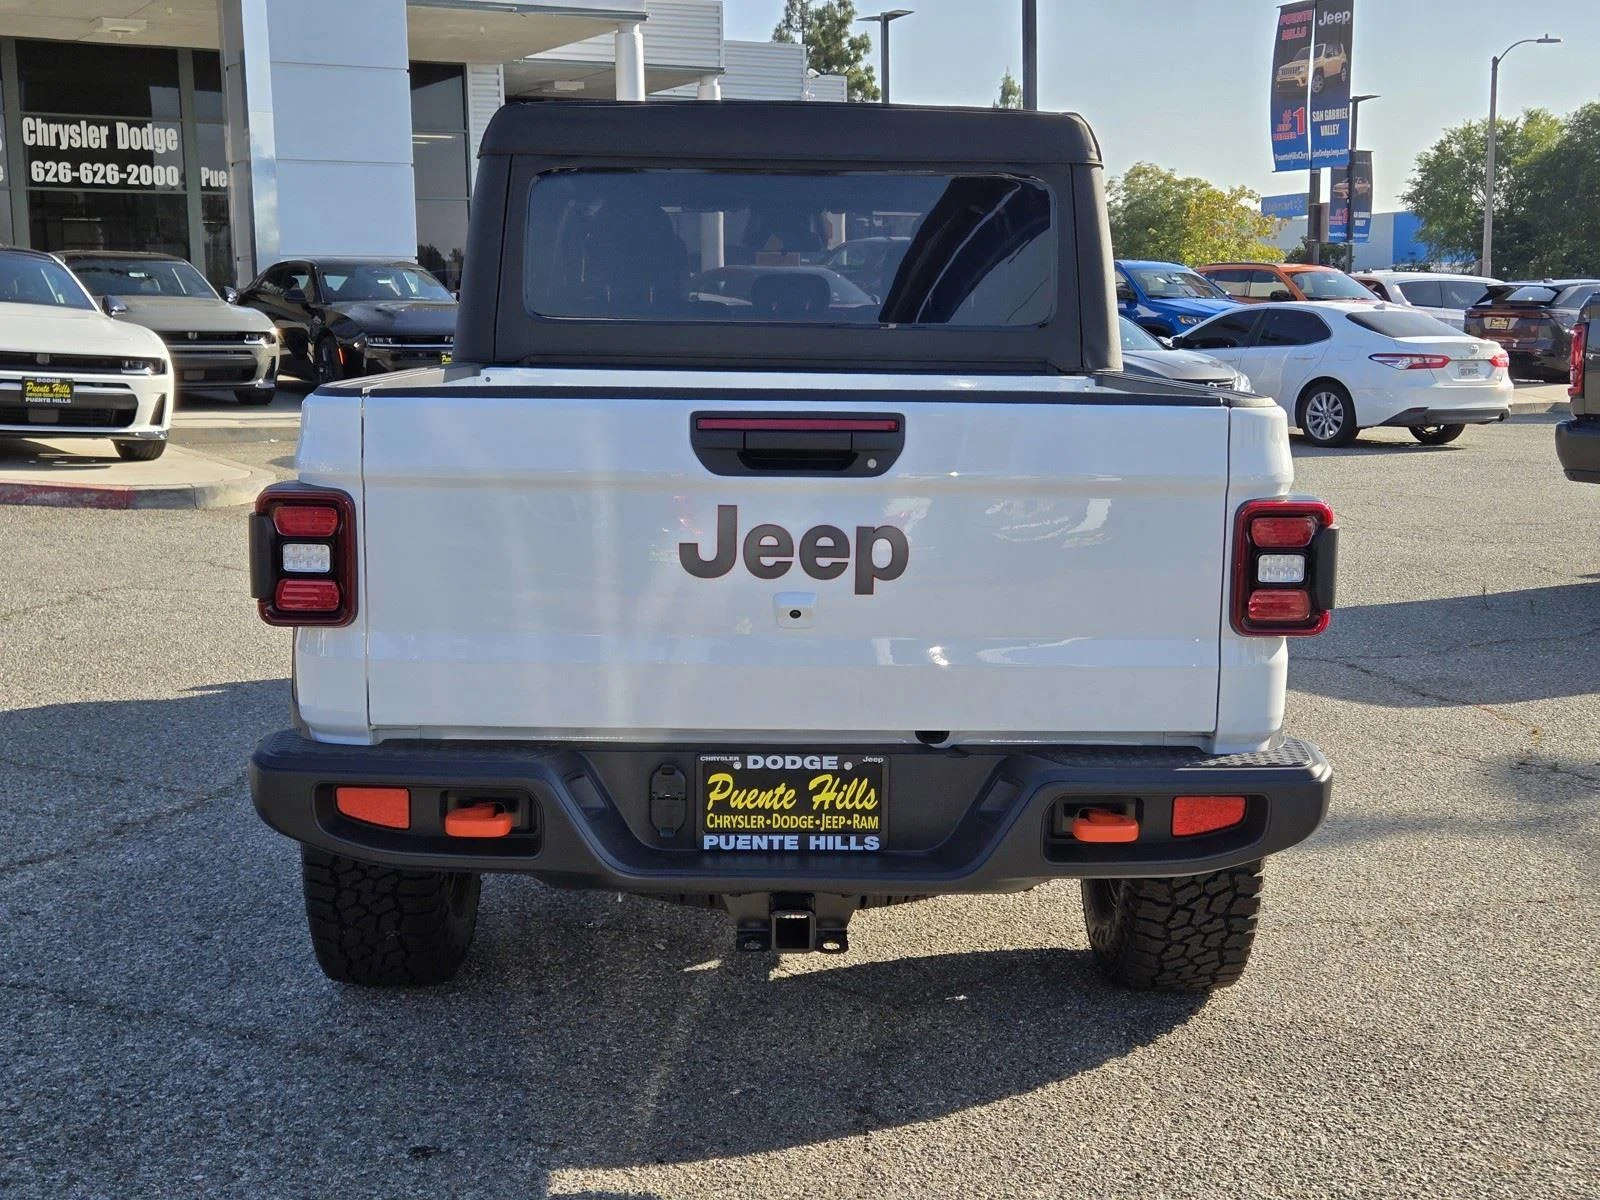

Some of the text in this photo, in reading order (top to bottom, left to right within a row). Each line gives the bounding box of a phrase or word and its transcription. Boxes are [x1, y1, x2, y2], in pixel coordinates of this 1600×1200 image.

[1319, 10, 1351, 25] Jeep
[1312, 107, 1349, 122] SAN GABRIEL
[22, 117, 109, 150] Chrysler
[116, 121, 178, 154] Dodge
[1320, 123, 1340, 136] VALLEY
[31, 160, 179, 186] 626-626-2000
[26, 381, 70, 393] Puente Hills
[678, 504, 909, 595] Jeep
[747, 755, 839, 770] DODGE
[707, 772, 879, 811] Puente Hills
[703, 835, 880, 850] PUENTE HILLS
